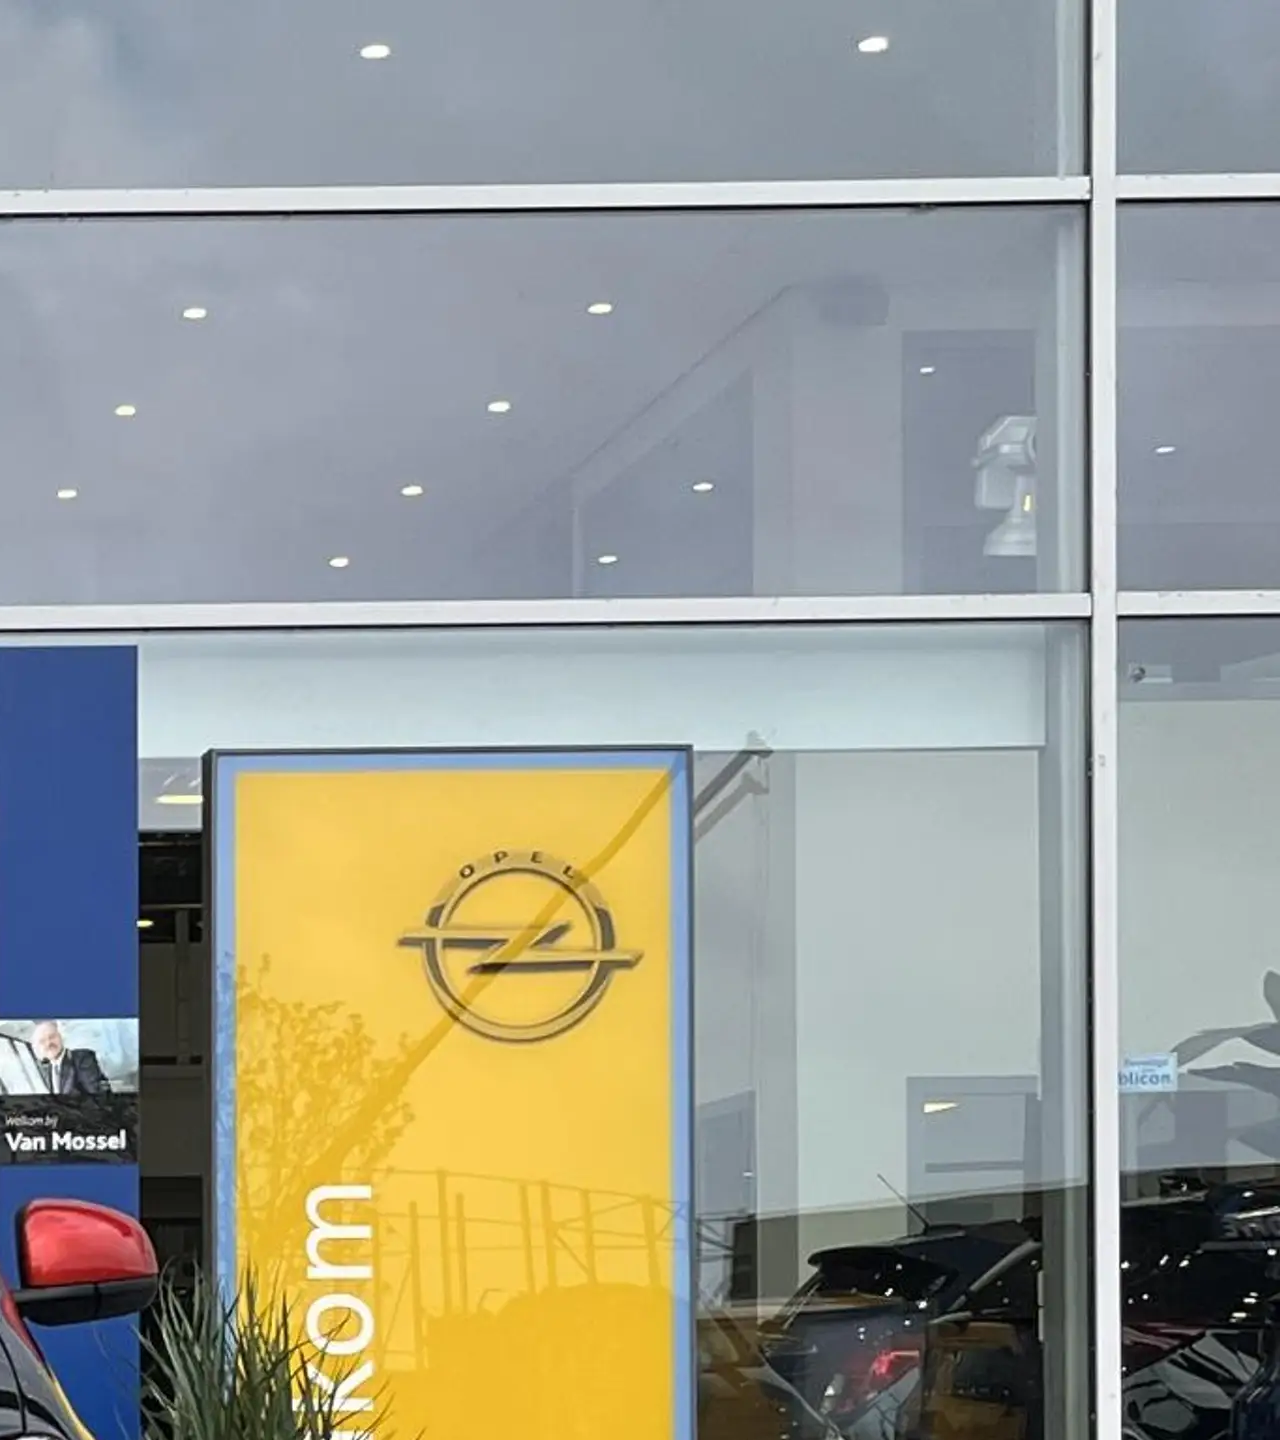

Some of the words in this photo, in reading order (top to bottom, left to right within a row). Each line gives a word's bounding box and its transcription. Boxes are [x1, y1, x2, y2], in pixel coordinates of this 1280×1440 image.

[459, 851, 574, 879] OPEL
[5, 1132, 46, 1151] Van
[52, 1129, 126, 1151] Mossel
